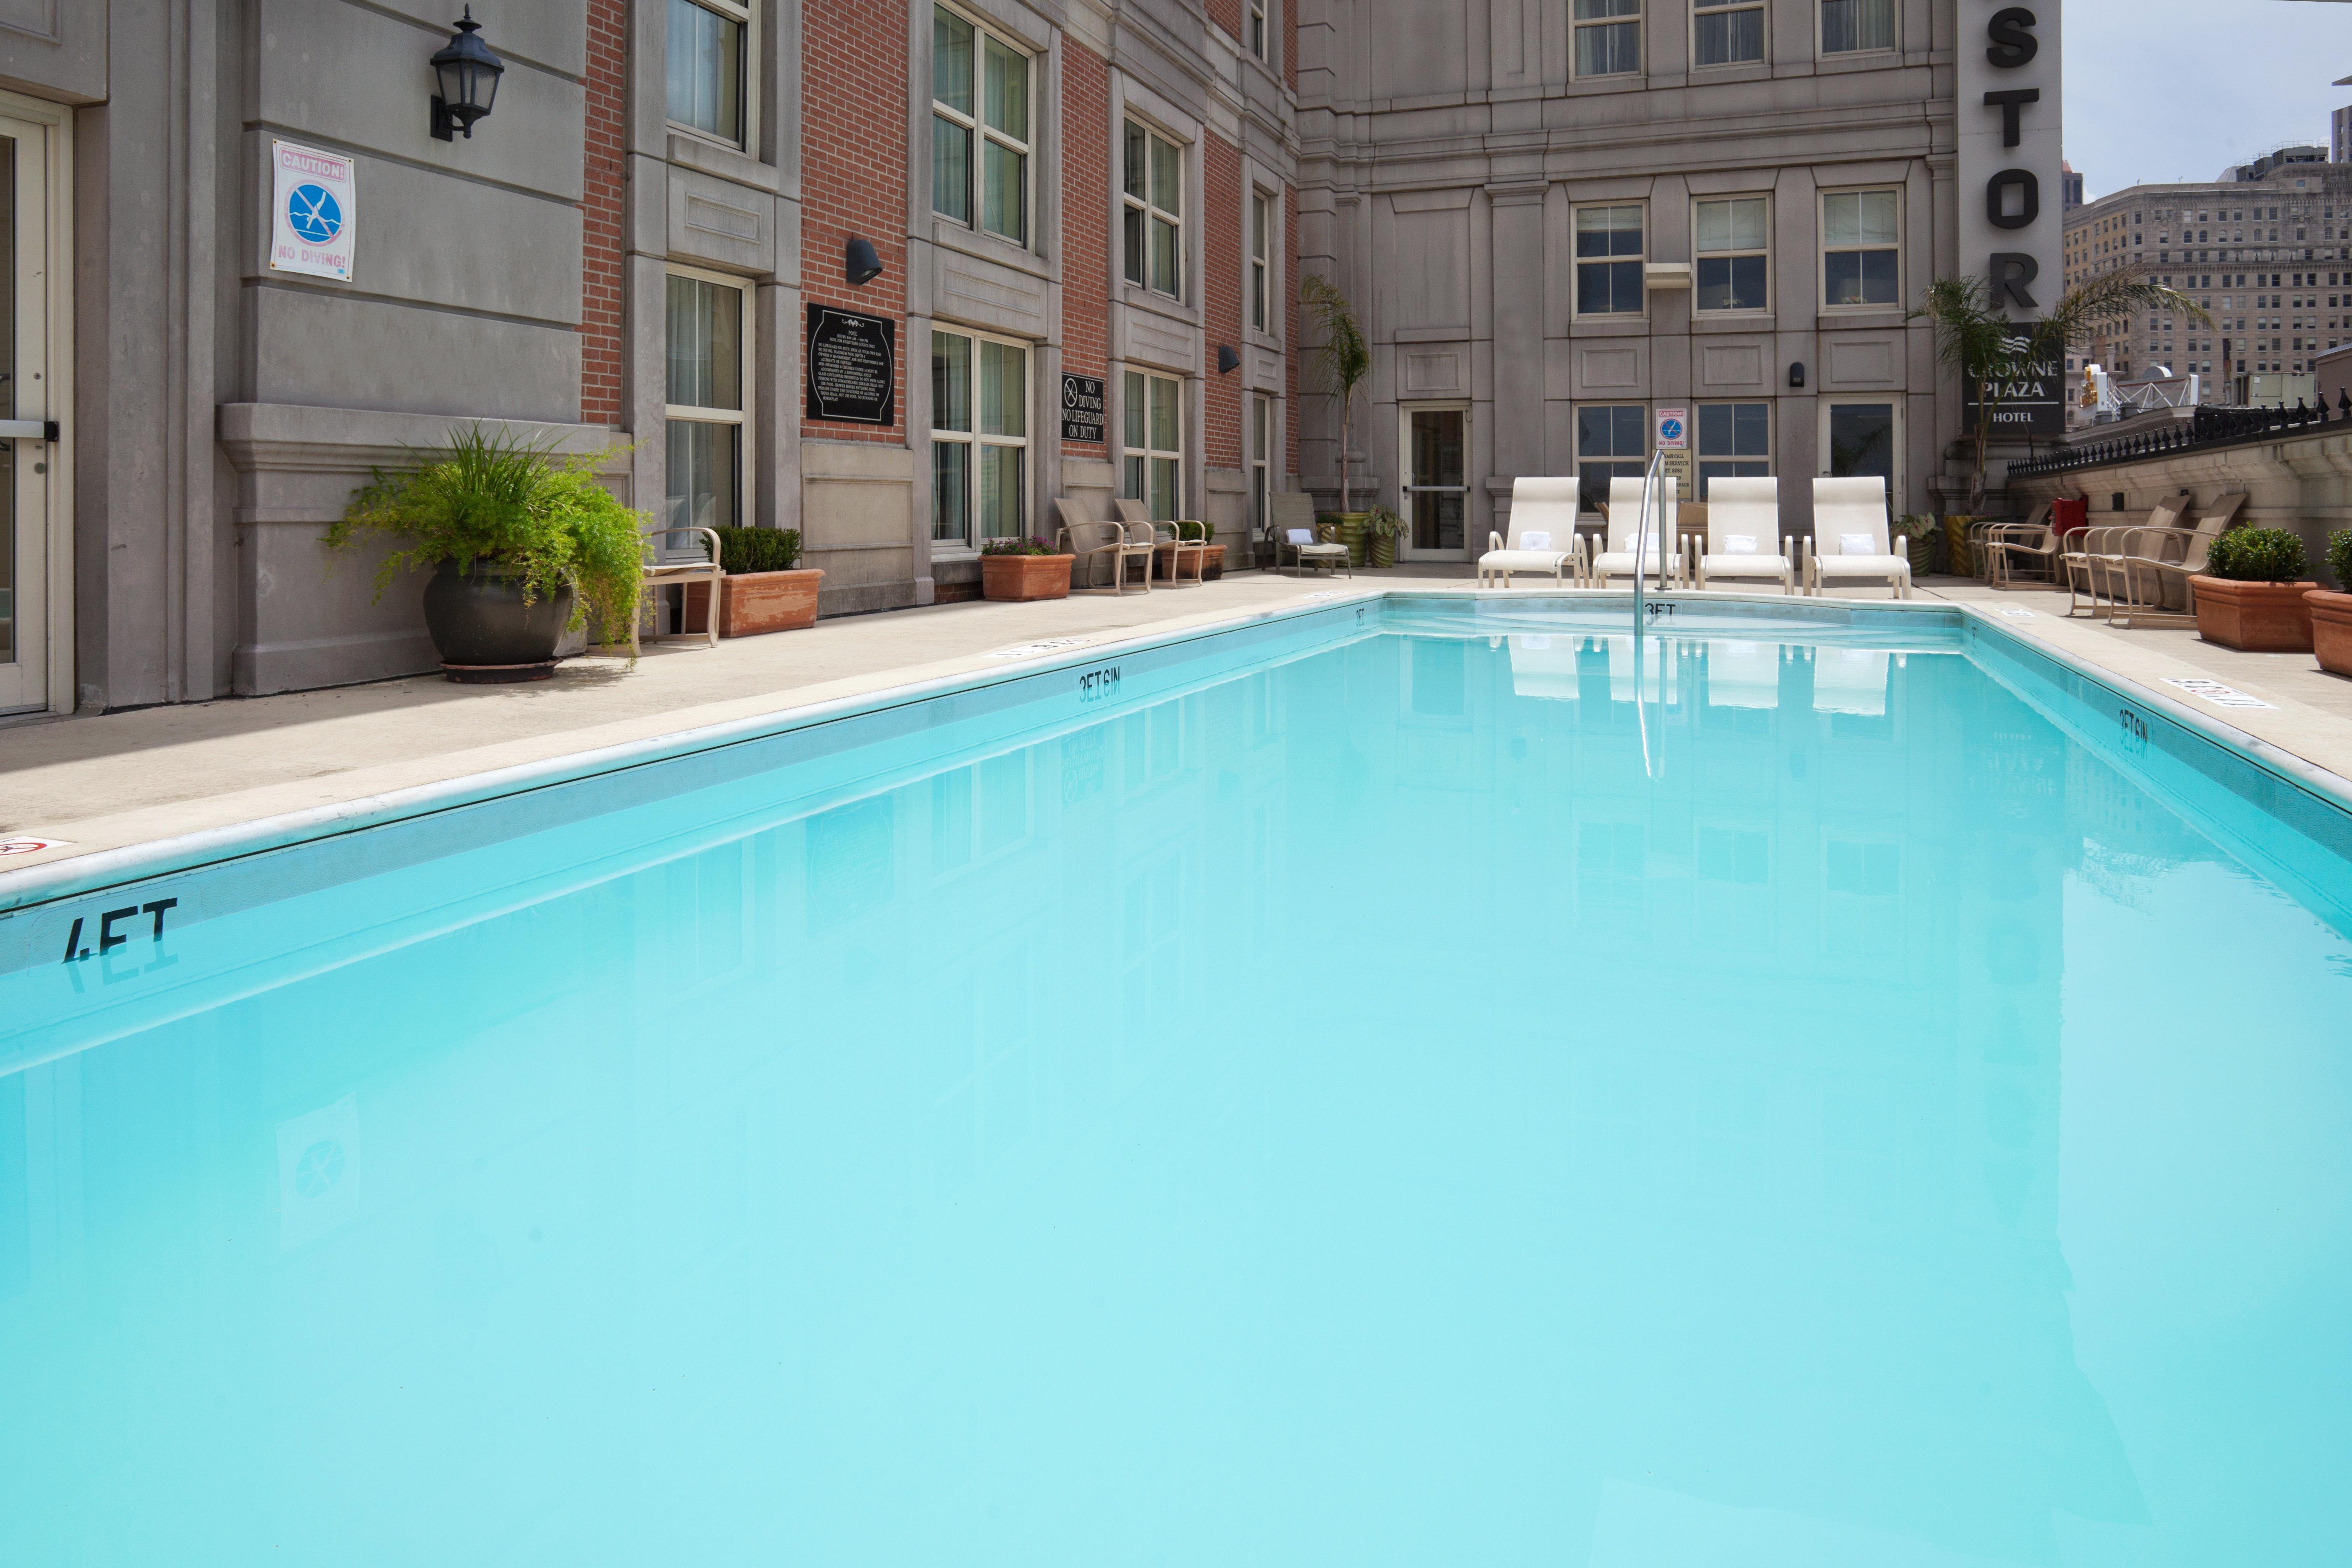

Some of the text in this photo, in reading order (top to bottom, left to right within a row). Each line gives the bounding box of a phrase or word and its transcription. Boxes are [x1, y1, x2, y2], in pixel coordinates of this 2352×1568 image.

[282, 152, 344, 178] CAUTION!
[278, 245, 345, 268] NO DIVING!
[1085, 381, 1095, 394] NO
[1981, 382, 2045, 397] PLAZA
[1079, 395, 1101, 410] DIVING
[1062, 408, 1103, 425] NO LIFEGUARD
[1993, 413, 2033, 422] HOTEL
[1069, 425, 1097, 439] ON DUTY
